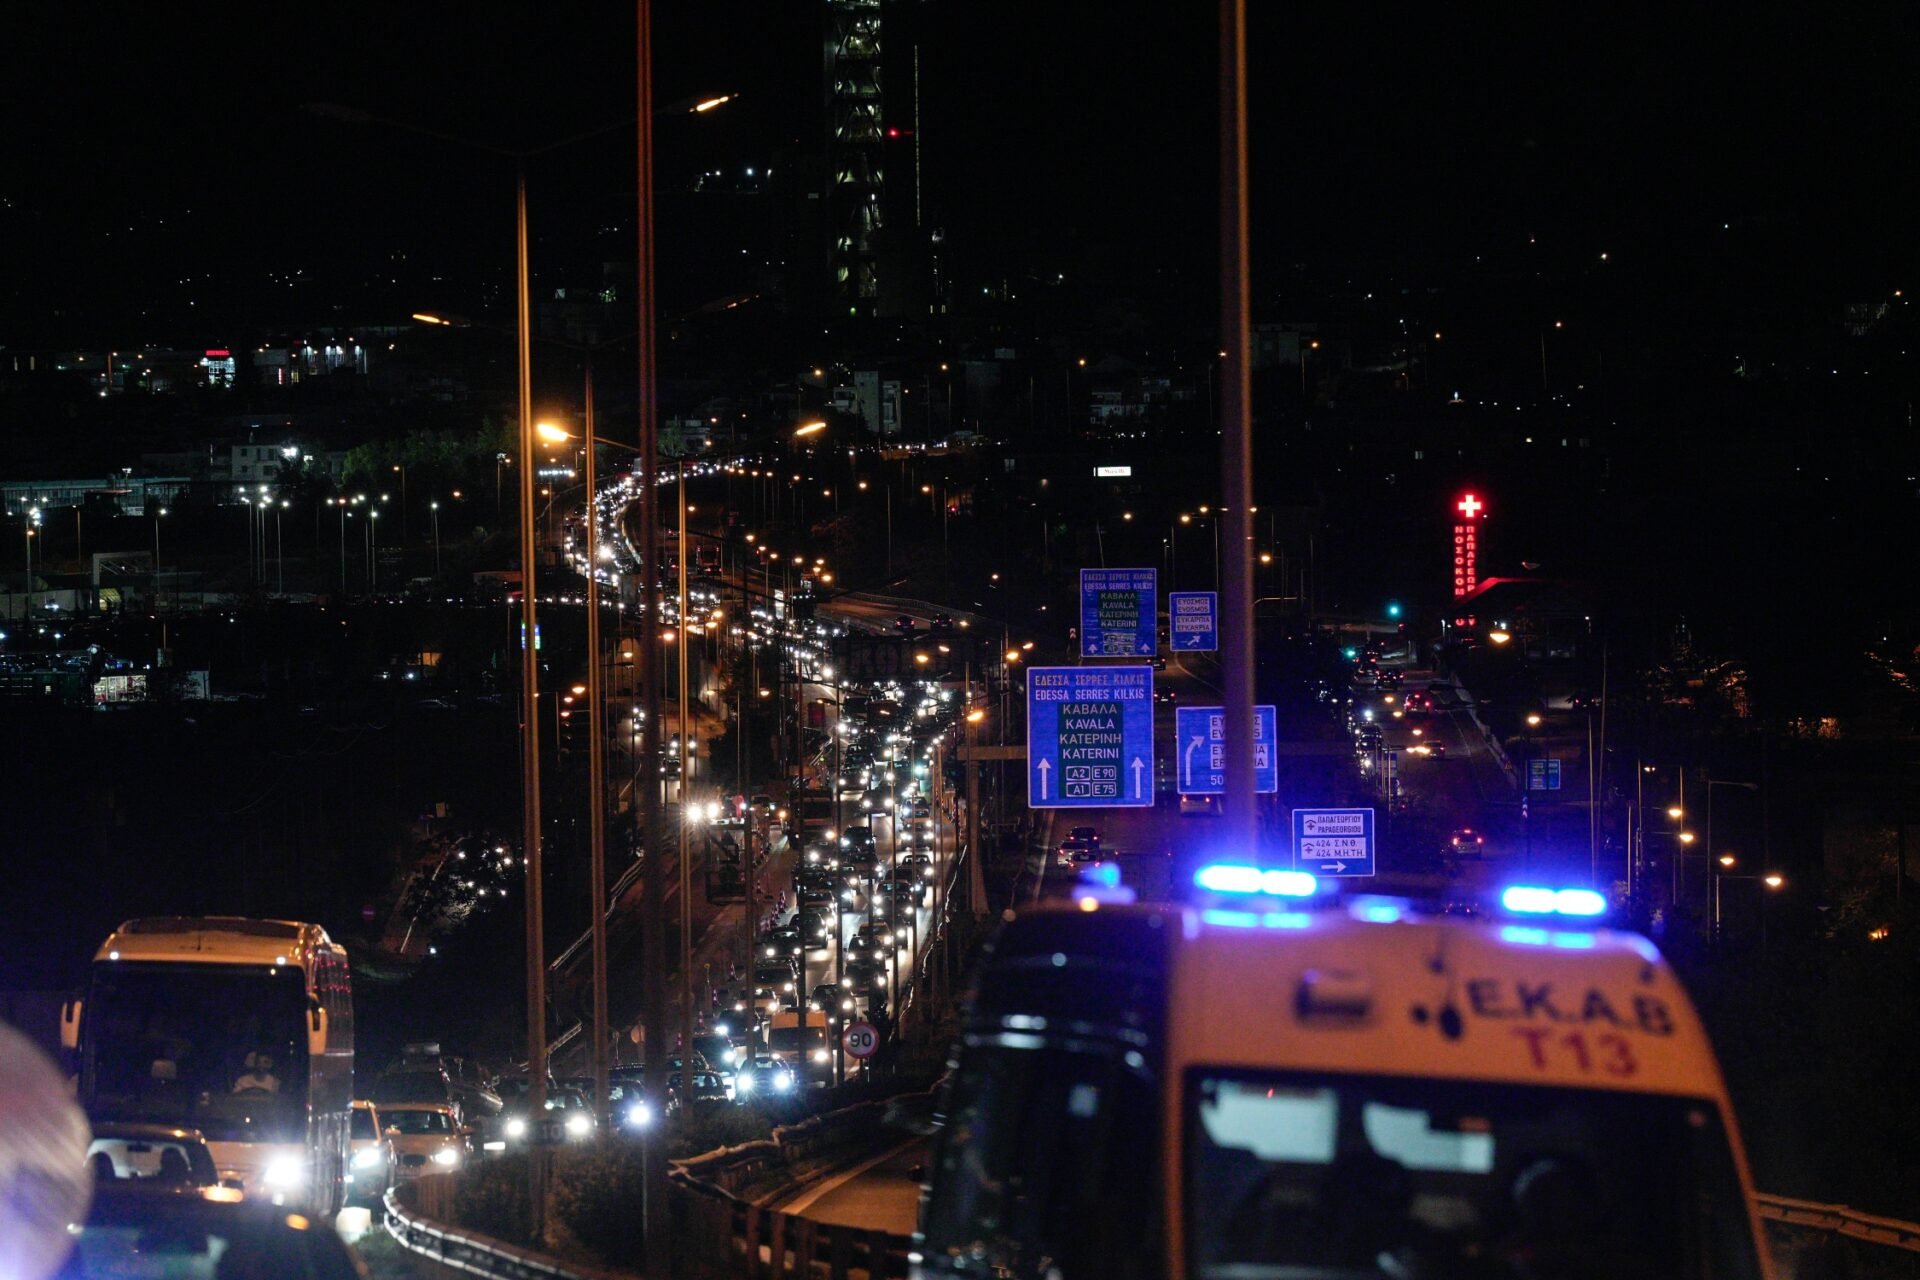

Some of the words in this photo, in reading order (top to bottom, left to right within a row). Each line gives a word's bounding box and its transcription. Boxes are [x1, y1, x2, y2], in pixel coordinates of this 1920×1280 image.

[1035, 675, 1069, 686] ΕΔΕΣΣΑ
[1075, 675, 1108, 686] ΣΕΡΡΕΣ
[1114, 674, 1144, 685] ΚΙΛΚΙΣ
[1035, 690, 1069, 700] EDESSA
[1075, 689, 1109, 700] SERRES
[1114, 688, 1144, 699] KILKIS
[1063, 704, 1117, 714] ΚΑΒΑΛΑ
[1066, 719, 1115, 729] KAVALA
[1060, 733, 1122, 744] ΚΑΤΕΡΙΝΗ
[1063, 748, 1119, 759] KATERINI
[1071, 769, 1085, 778] A2
[1094, 769, 1101, 778] E
[1102, 769, 1115, 778] 90
[1073, 785, 1085, 794] A1
[1094, 784, 1101, 794] E
[1103, 784, 1115, 794] 75
[1317, 815, 1361, 824] ΠΑΠΑΓΕΩΡΓΙΟΥ
[1317, 825, 1361, 834] PAPAGEORGIOU
[850, 1032, 872, 1047] 90
